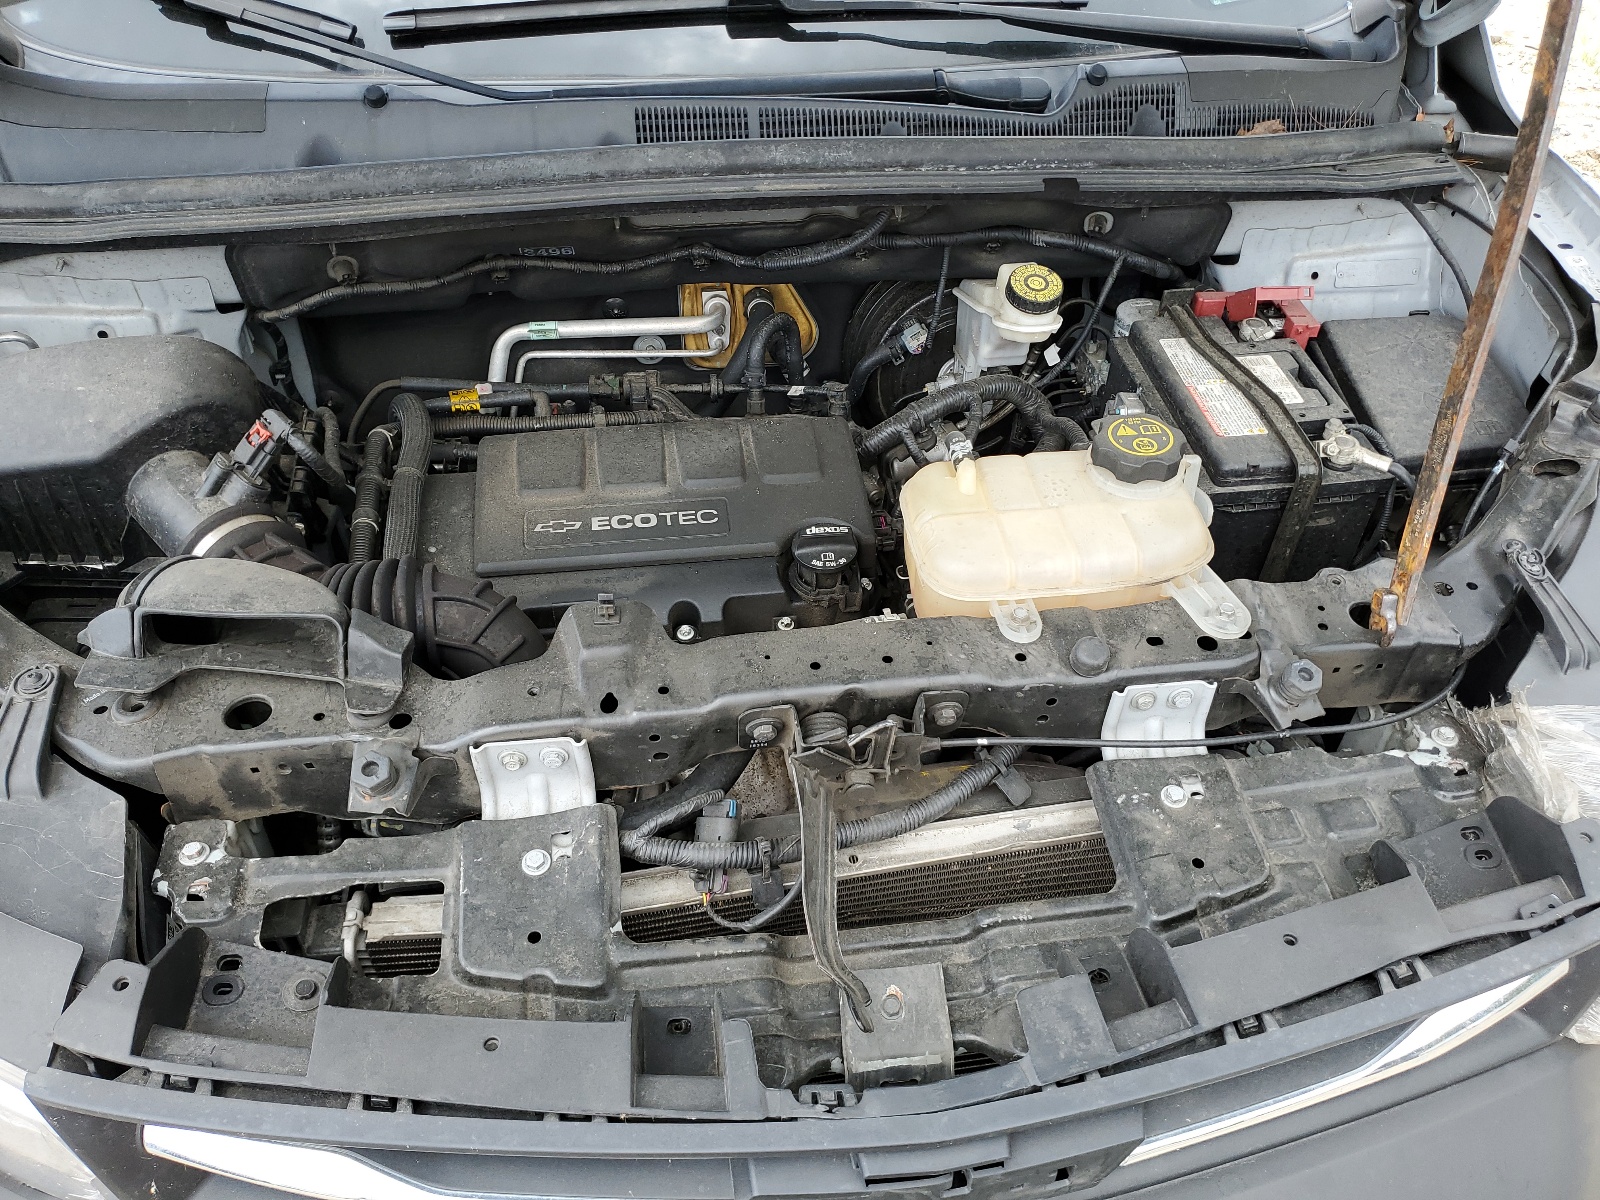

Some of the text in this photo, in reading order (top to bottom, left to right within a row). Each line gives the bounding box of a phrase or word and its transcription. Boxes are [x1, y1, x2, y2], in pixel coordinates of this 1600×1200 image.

[591, 509, 719, 531] ECOTEC
[806, 526, 849, 535] dexos
[811, 557, 847, 567] SAE 5W-30
[83, 692, 101, 704] Made
